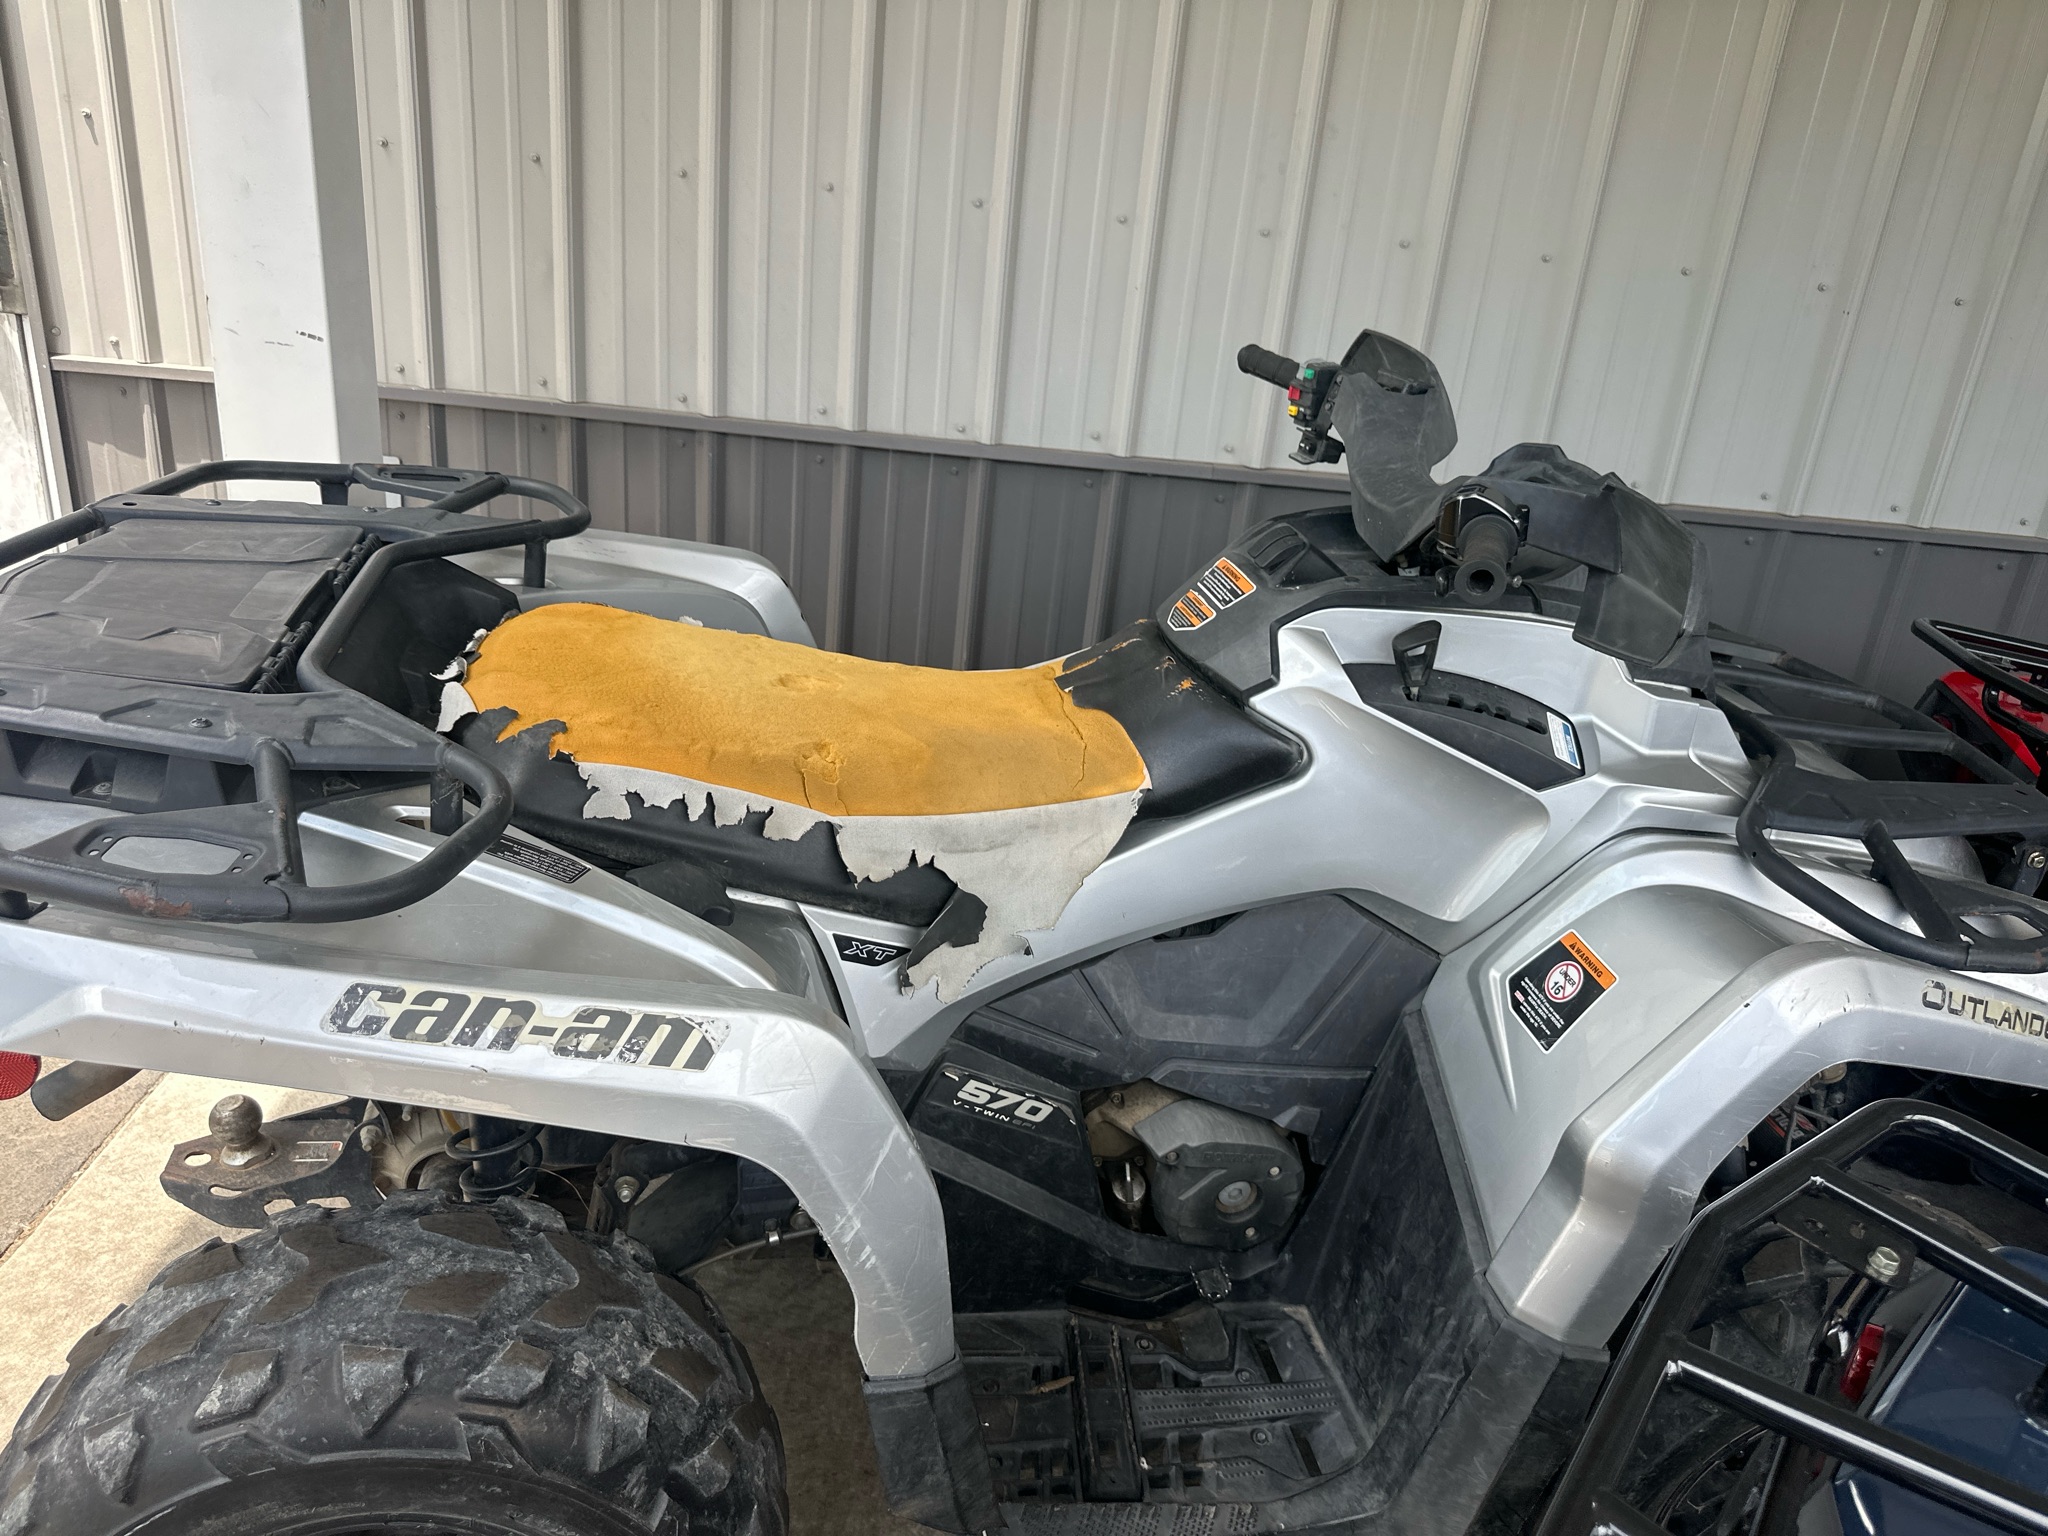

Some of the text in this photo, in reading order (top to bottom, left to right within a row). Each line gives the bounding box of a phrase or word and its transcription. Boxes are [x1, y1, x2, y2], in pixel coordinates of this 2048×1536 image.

[843, 941, 897, 960] XT
[1575, 946, 1603, 978] WARNING
[1559, 968, 1576, 987] UNDER
[1551, 981, 1564, 995] 16
[957, 1079, 1053, 1122] 570
